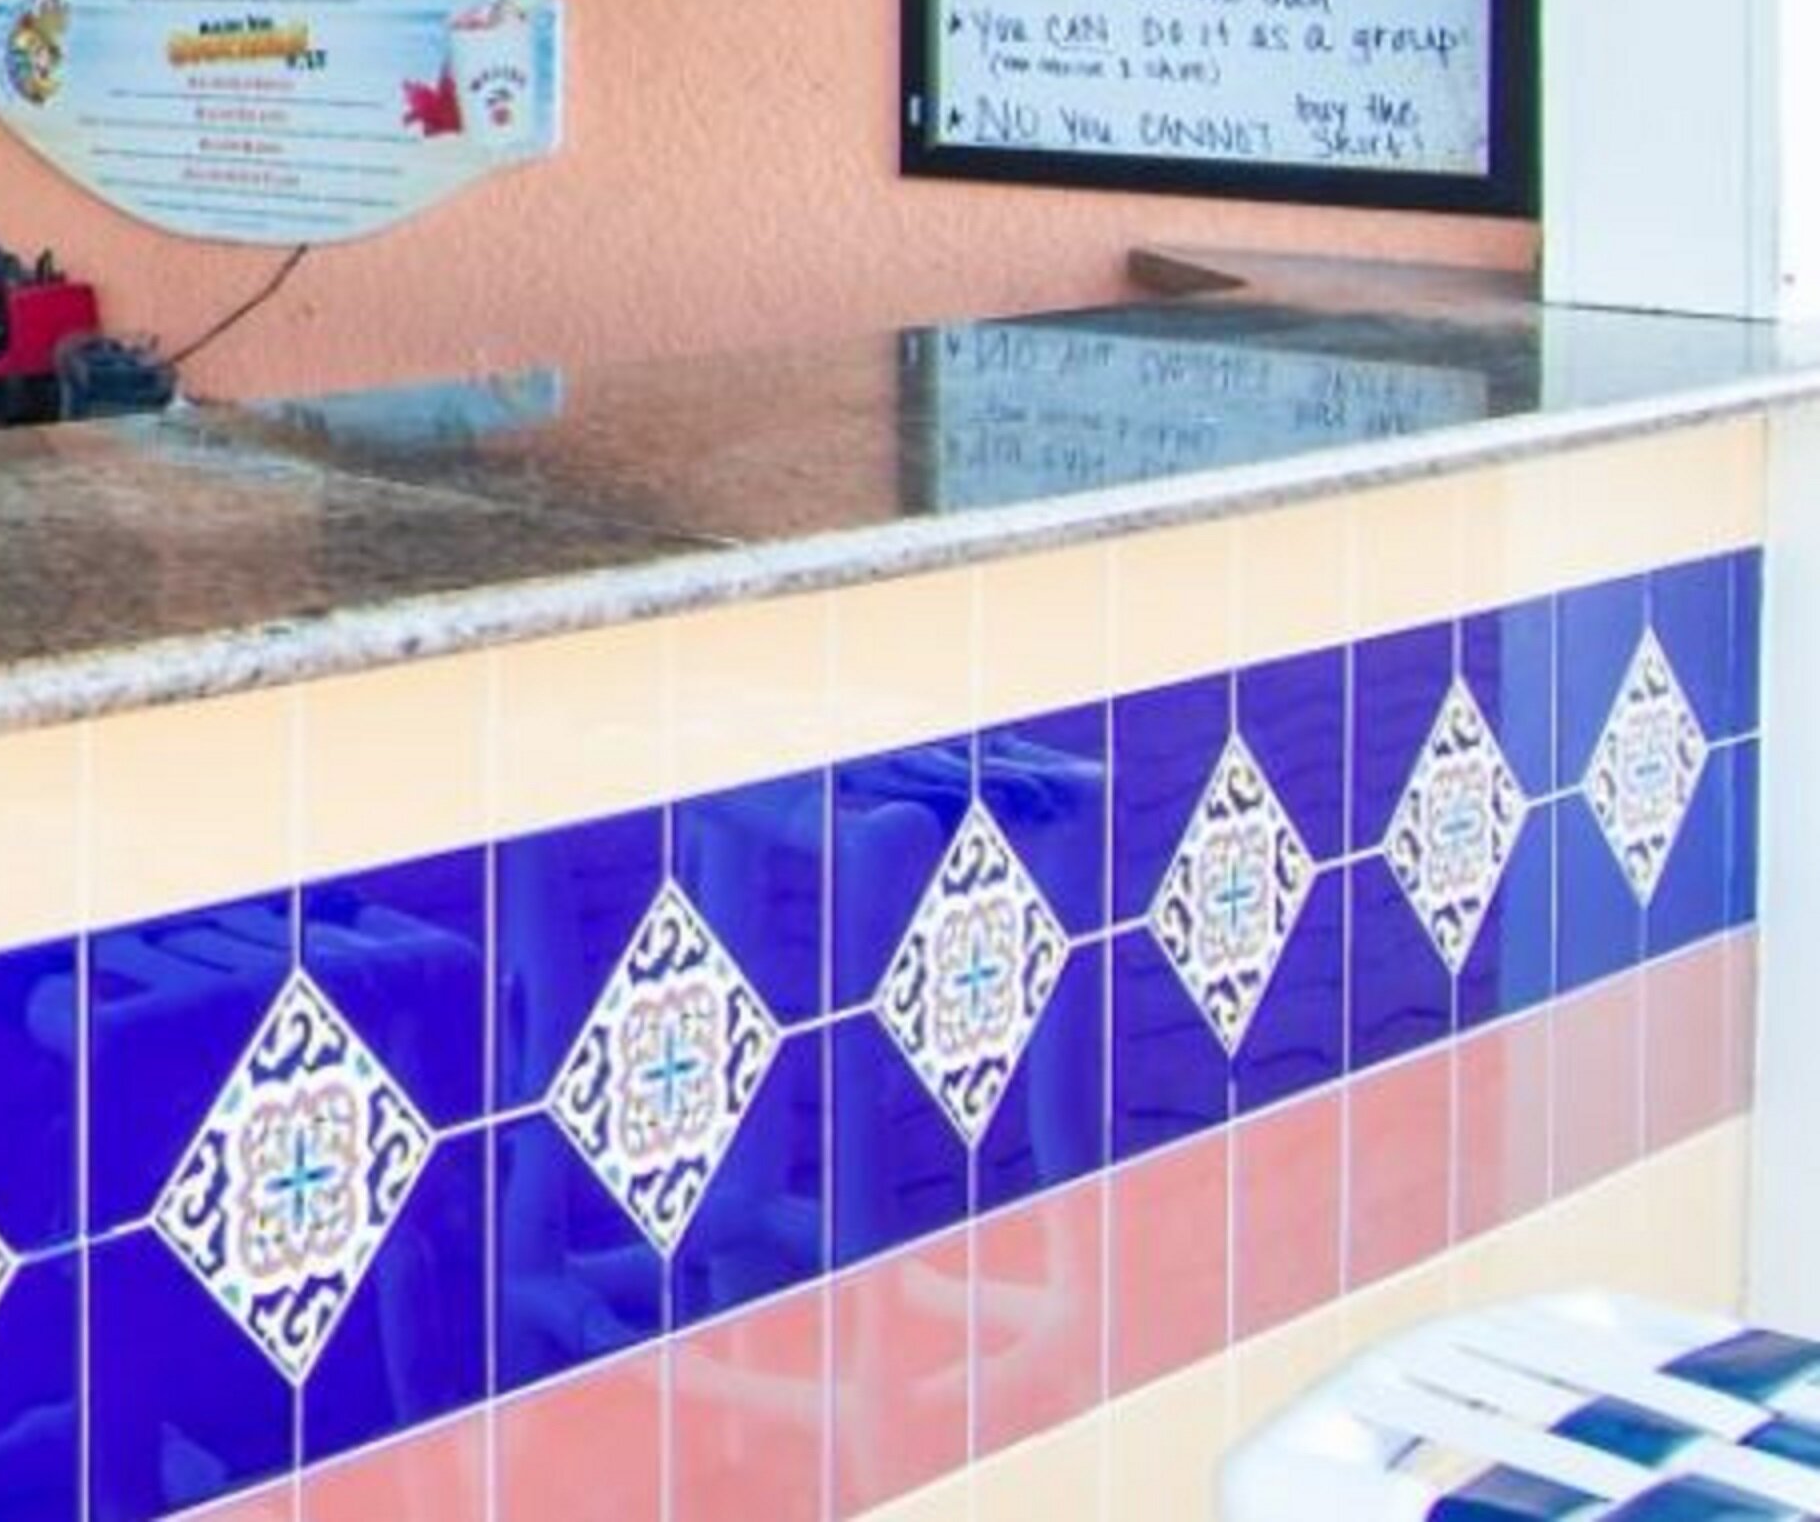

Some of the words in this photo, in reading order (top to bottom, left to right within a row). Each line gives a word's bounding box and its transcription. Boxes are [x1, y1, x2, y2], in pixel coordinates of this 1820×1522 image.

[1045, 13, 1111, 48] CAN
[1301, 22, 1334, 51] a
[1294, 90, 1348, 138] buy
[1363, 92, 1420, 128] the
